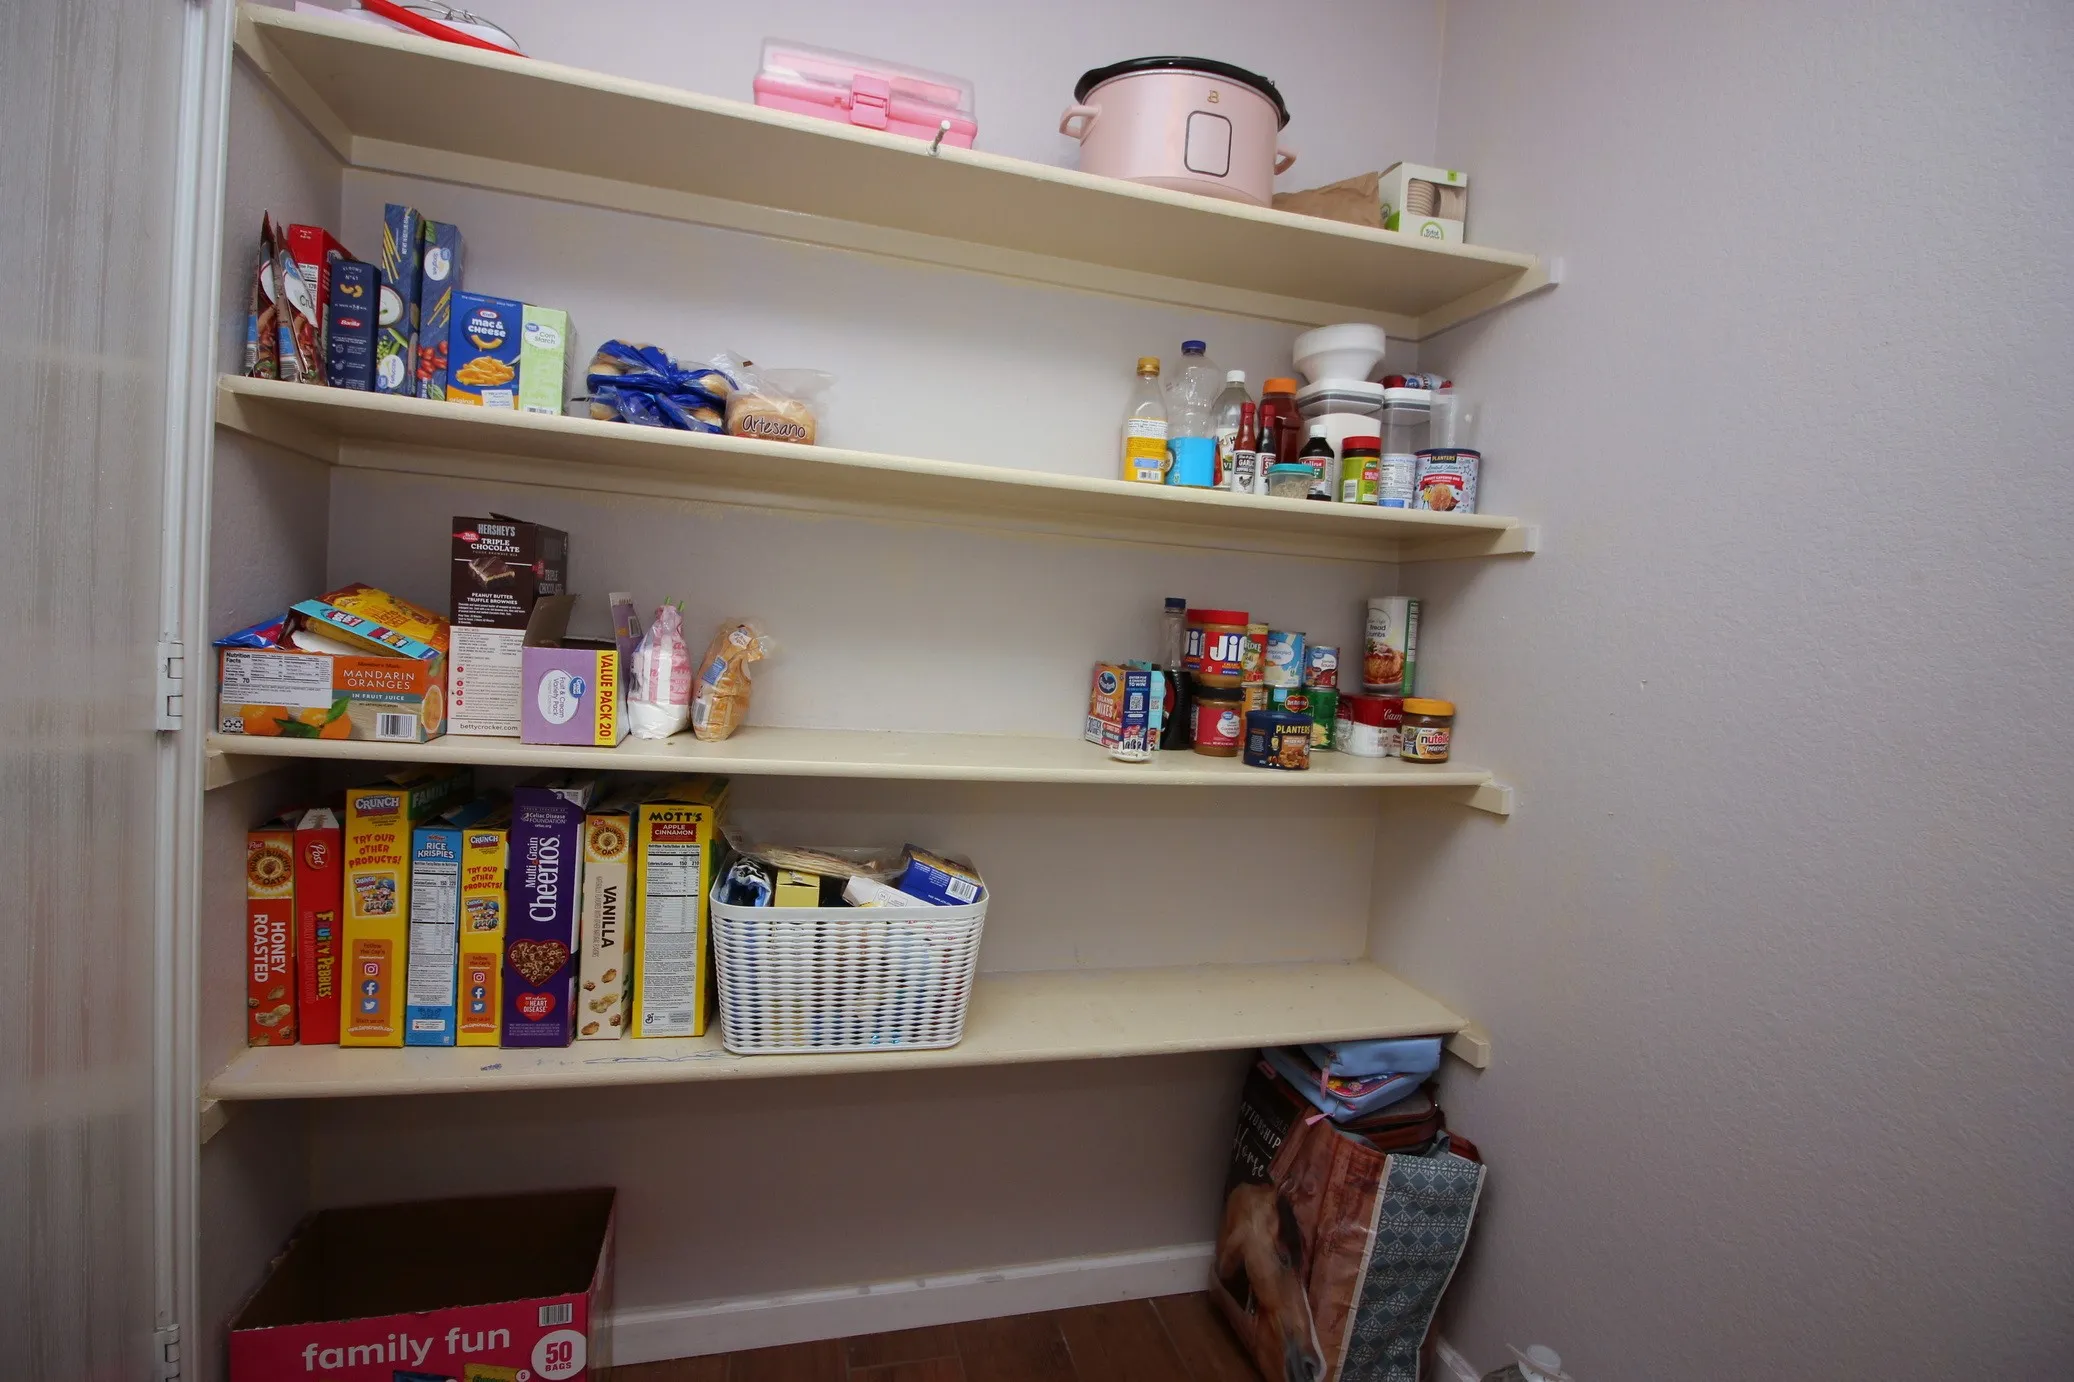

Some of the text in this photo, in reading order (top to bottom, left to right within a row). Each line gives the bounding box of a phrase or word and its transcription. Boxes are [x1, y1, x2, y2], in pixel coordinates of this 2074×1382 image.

[471, 318, 504, 329] mac &
[535, 335, 556, 345] Starch
[539, 331, 556, 339] Corn
[449, 396, 475, 405] original
[477, 523, 516, 537] HERSHEY'S
[471, 543, 520, 553] CHOCOLATE
[481, 538, 510, 546] TRIPLE
[1210, 635, 1247, 661] Jif
[343, 669, 415, 681] MANDARIN
[601, 653, 614, 687] VALUE
[347, 678, 411, 690] ORANGES
[600, 690, 613, 721] PACK
[1096, 702, 1113, 718] MIXES
[1383, 708, 1402, 723] Cam
[460, 723, 518, 731] bettycrocker.com
[599, 722, 611, 737] 20
[1275, 725, 1310, 734] PLANTERS
[412, 784, 449, 808] FAMILY
[355, 797, 400, 809] CRUNCH
[649, 811, 702, 822] MOTT'S
[353, 833, 395, 845] TRY OUR
[470, 835, 499, 844] CRUNCH
[593, 827, 623, 845] HONEY BUNCHES
[359, 844, 390, 855] OTHER
[426, 842, 447, 851] RICE
[602, 845, 620, 856] OATS
[310, 843, 326, 865] Post
[417, 850, 454, 859] KRISPIES
[249, 850, 291, 872] HONEY BUNCHES
[349, 856, 402, 869] PRODUCTS!
[525, 836, 538, 888] Multi Grain
[467, 866, 481, 874] TRY
[263, 874, 286, 885] OATS
[529, 836, 560, 922] Cheerios
[463, 882, 502, 892] PRODUCTS!
[601, 886, 617, 949] VANILLA
[254, 914, 269, 983] ROASTED
[270, 922, 285, 974] HONEY
[1234, 1123, 1264, 1178] Horse
[302, 1327, 510, 1372] family fun
[545, 1340, 573, 1365] 50
[545, 1363, 572, 1372] BAGS
[520, 1371, 527, 1380] 6
